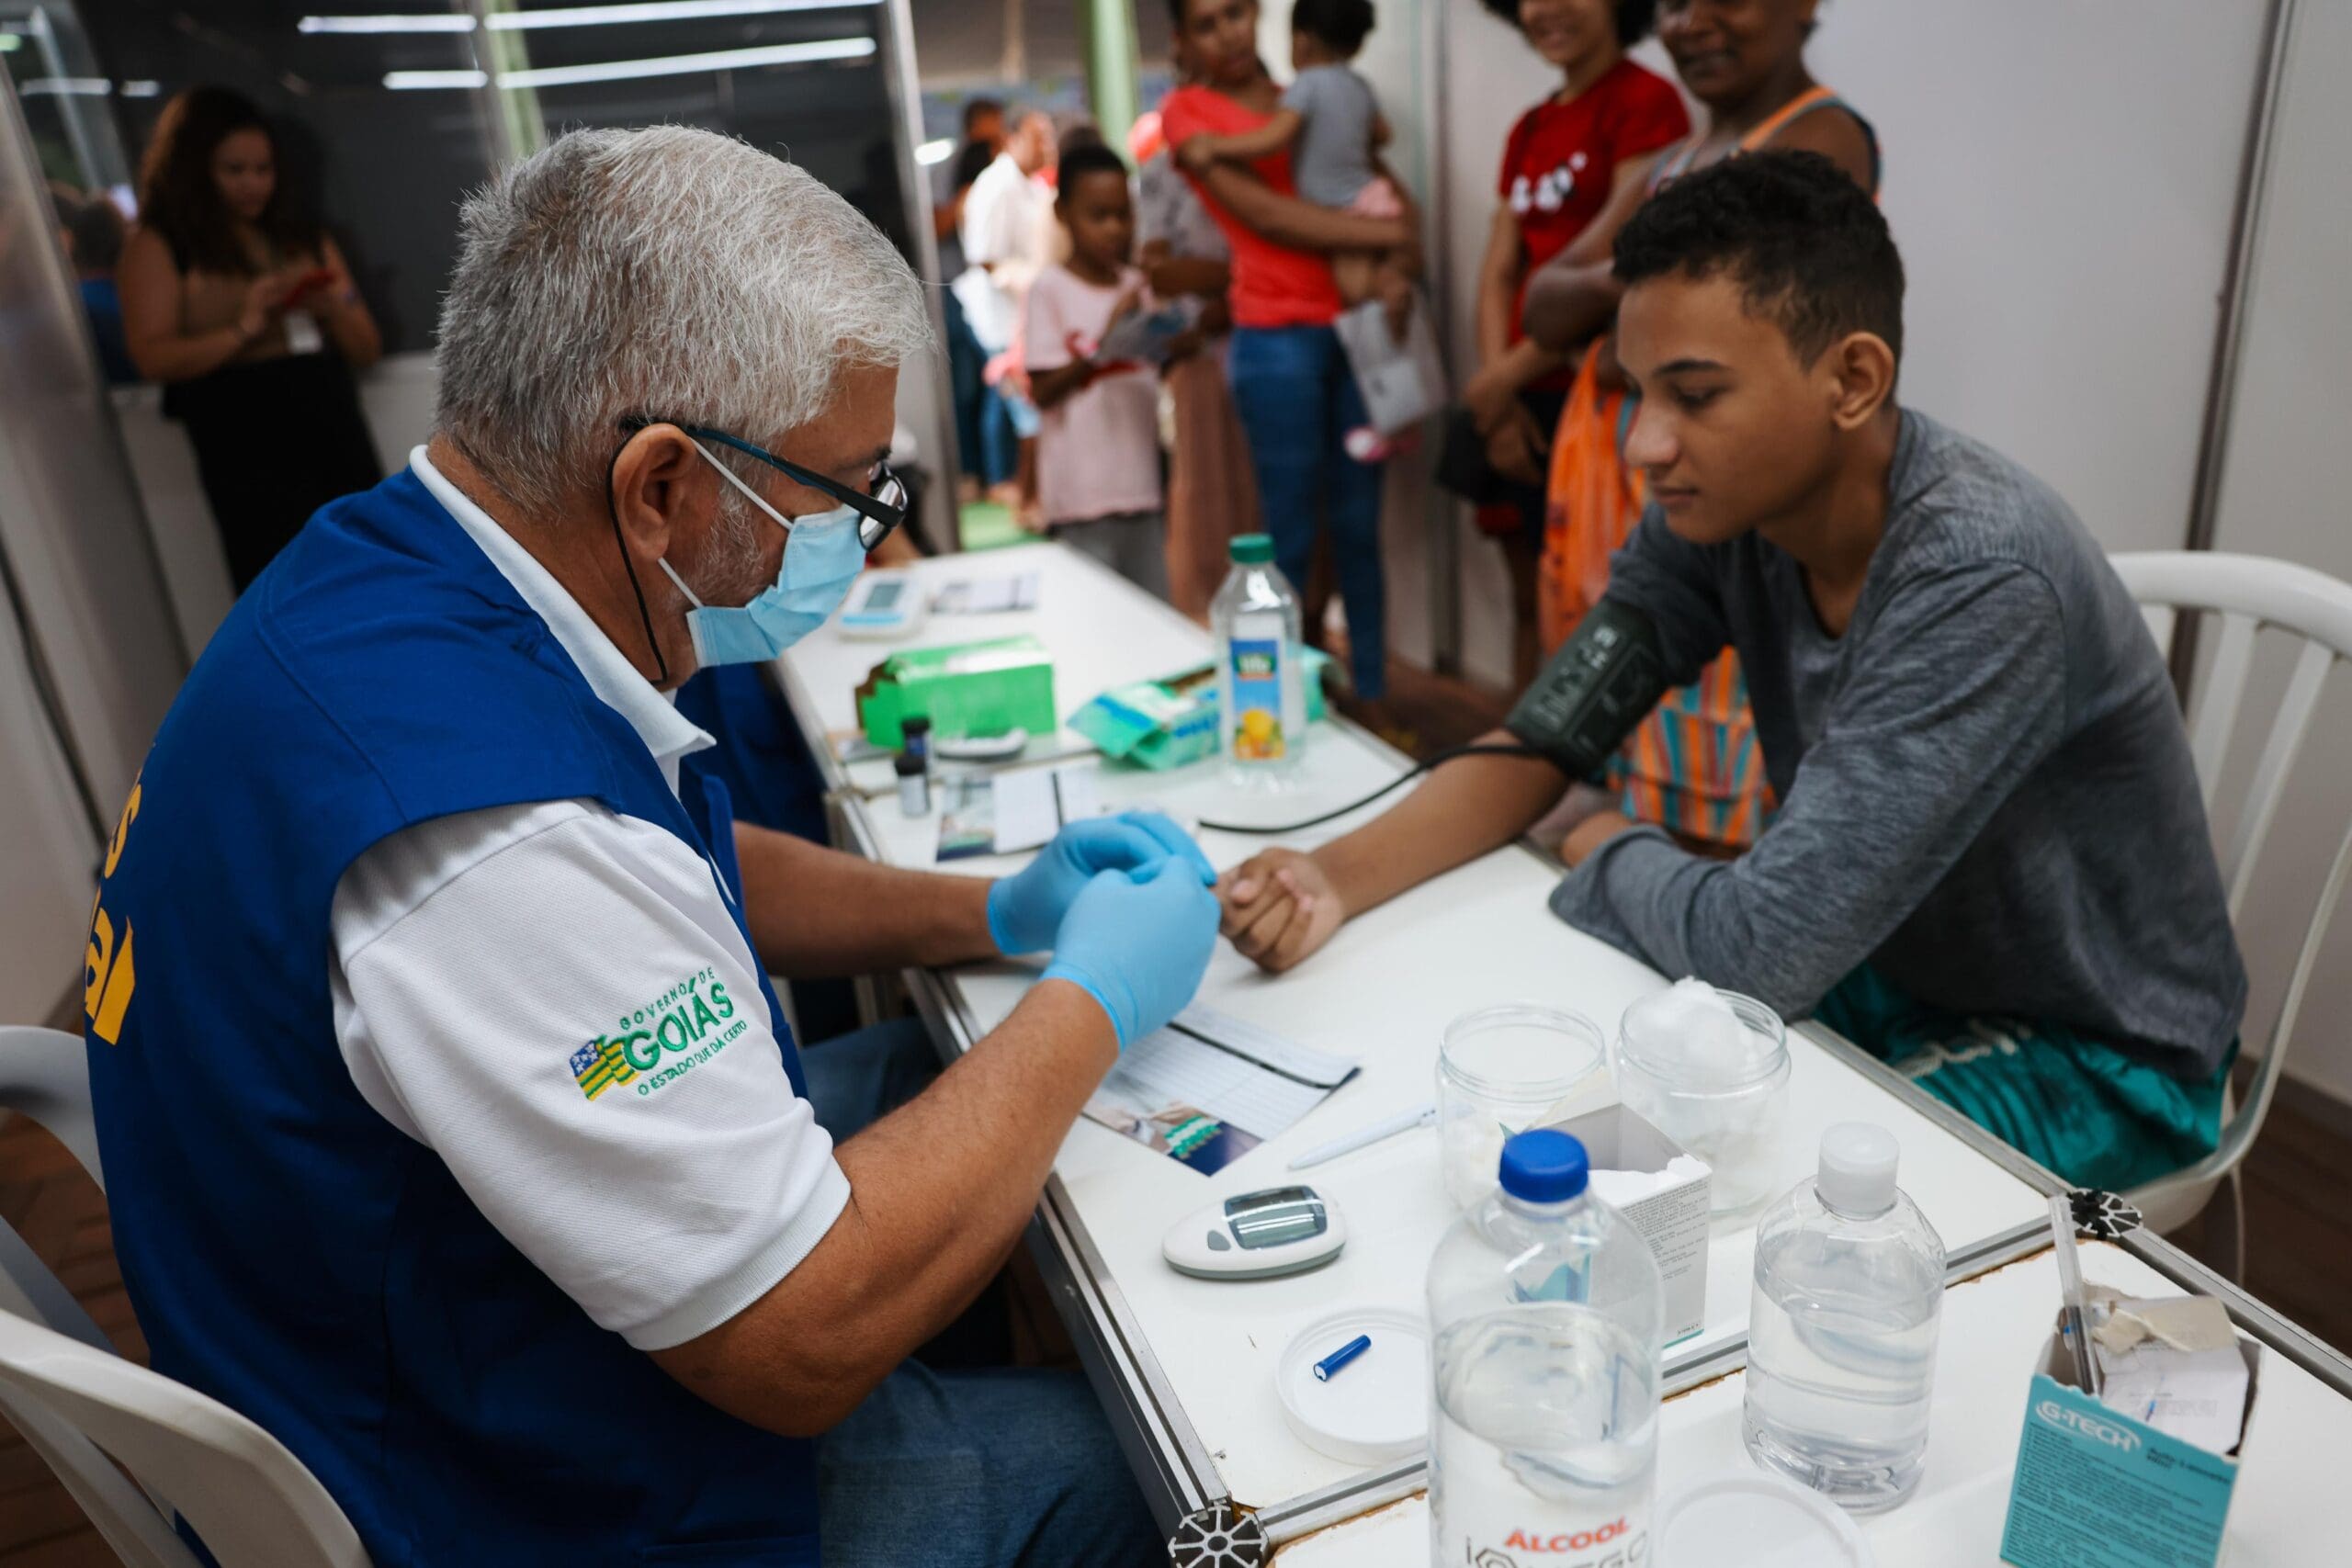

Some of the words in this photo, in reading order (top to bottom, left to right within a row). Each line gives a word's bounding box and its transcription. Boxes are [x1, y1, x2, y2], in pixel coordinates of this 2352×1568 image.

[619, 982, 687, 1031] GOVERNO
[698, 966, 715, 984] DE
[622, 976, 734, 1071] GOIÁS
[638, 1084, 649, 1096] O
[650, 1056, 695, 1089] ESTADO
[694, 1047, 712, 1064] QUE
[724, 1020, 747, 1043] CERTO
[2041, 1399, 2132, 1453] G-TECH
